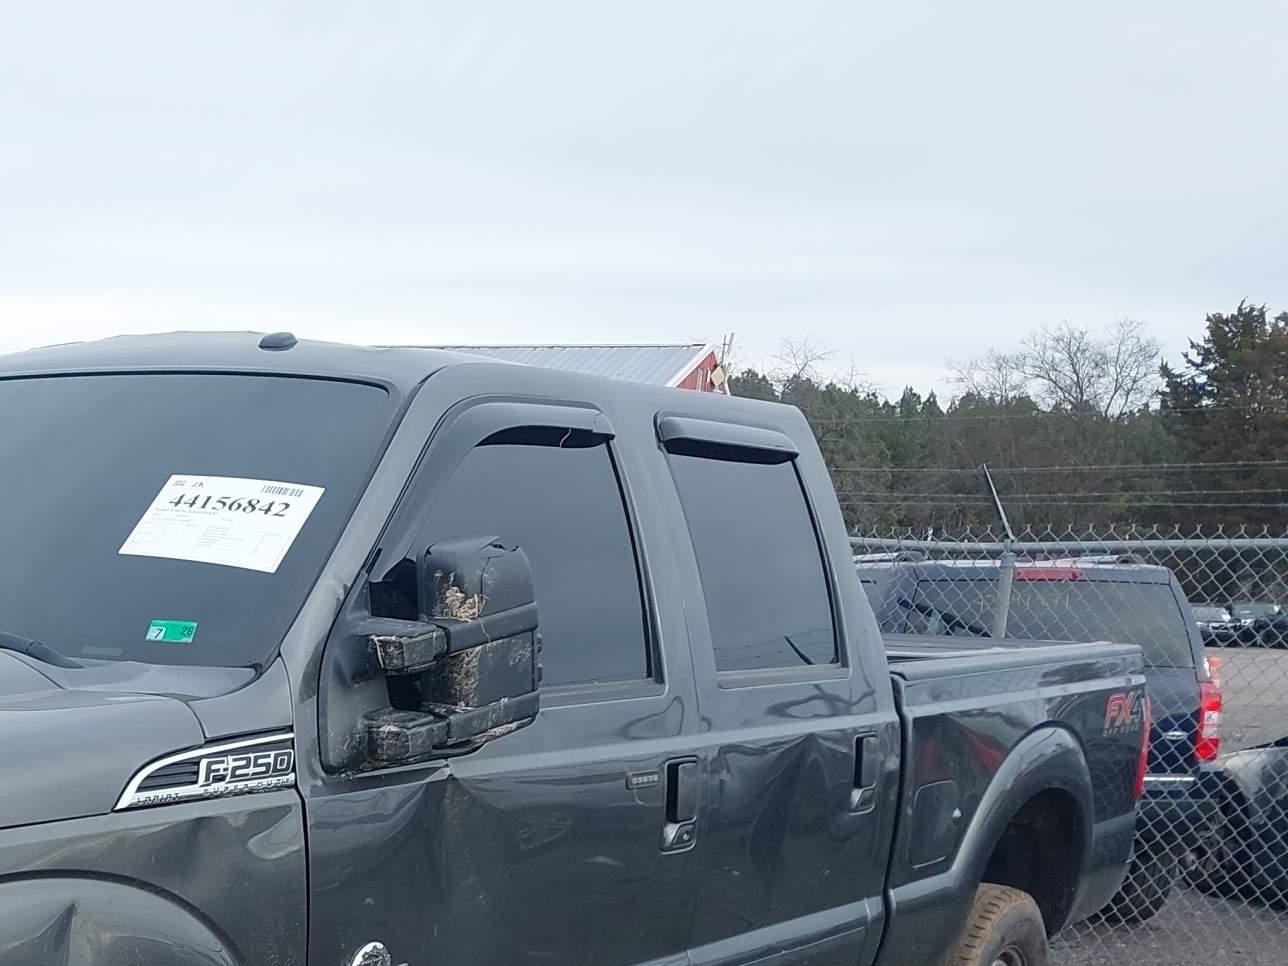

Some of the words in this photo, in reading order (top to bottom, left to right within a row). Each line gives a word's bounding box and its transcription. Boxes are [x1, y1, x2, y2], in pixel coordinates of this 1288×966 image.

[169, 493, 291, 517] 44156842
[154, 628, 164, 639] 7
[1104, 689, 1141, 729] FX4
[201, 750, 294, 784] F-250
[136, 792, 181, 806] LARIAT
[202, 784, 250, 797] SUPER
